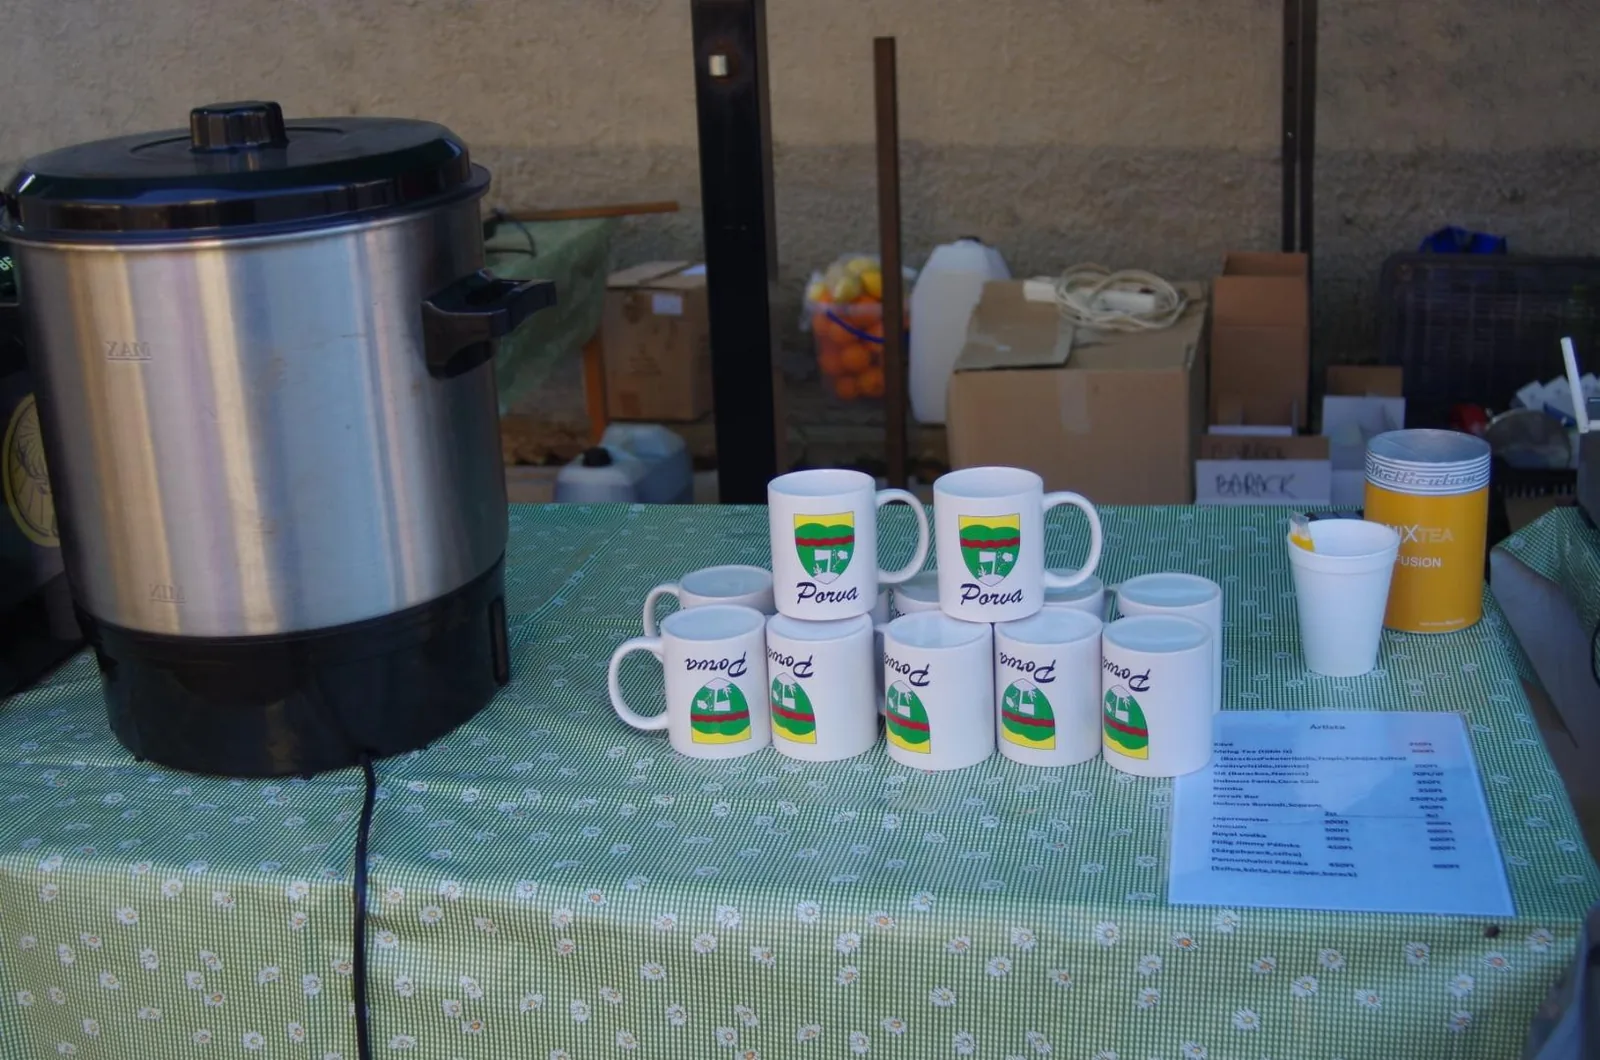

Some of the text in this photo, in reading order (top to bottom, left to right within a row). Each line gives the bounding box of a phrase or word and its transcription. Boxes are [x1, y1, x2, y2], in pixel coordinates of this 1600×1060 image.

[796, 581, 860, 605] Porva
[960, 582, 1023, 606] Porva
[684, 651, 748, 678] Porva
[999, 652, 1057, 684] Porva
